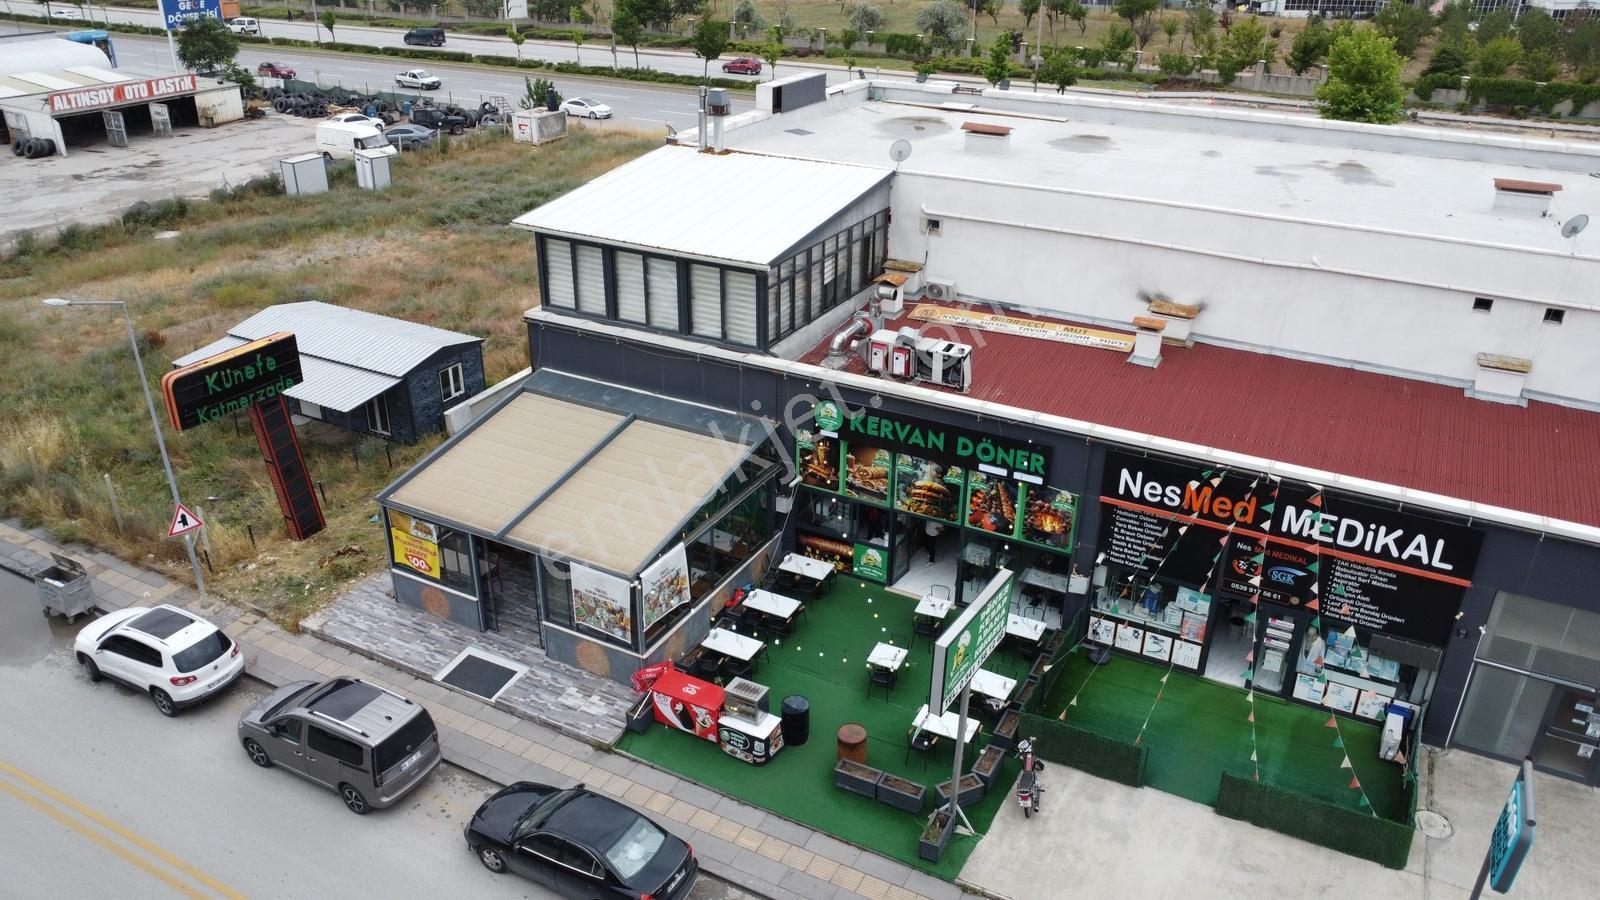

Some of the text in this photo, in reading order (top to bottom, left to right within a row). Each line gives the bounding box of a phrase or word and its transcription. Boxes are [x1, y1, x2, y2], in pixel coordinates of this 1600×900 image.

[53, 88, 115, 111] ALTINSOY
[124, 83, 148, 100] OTO
[205, 354, 277, 395] Künefe
[196, 376, 294, 424] Katmerzade
[850, 416, 1046, 475] KERVAN DÖNER
[1237, 542, 1251, 551] Nes
[1272, 570, 1295, 584] SGK
